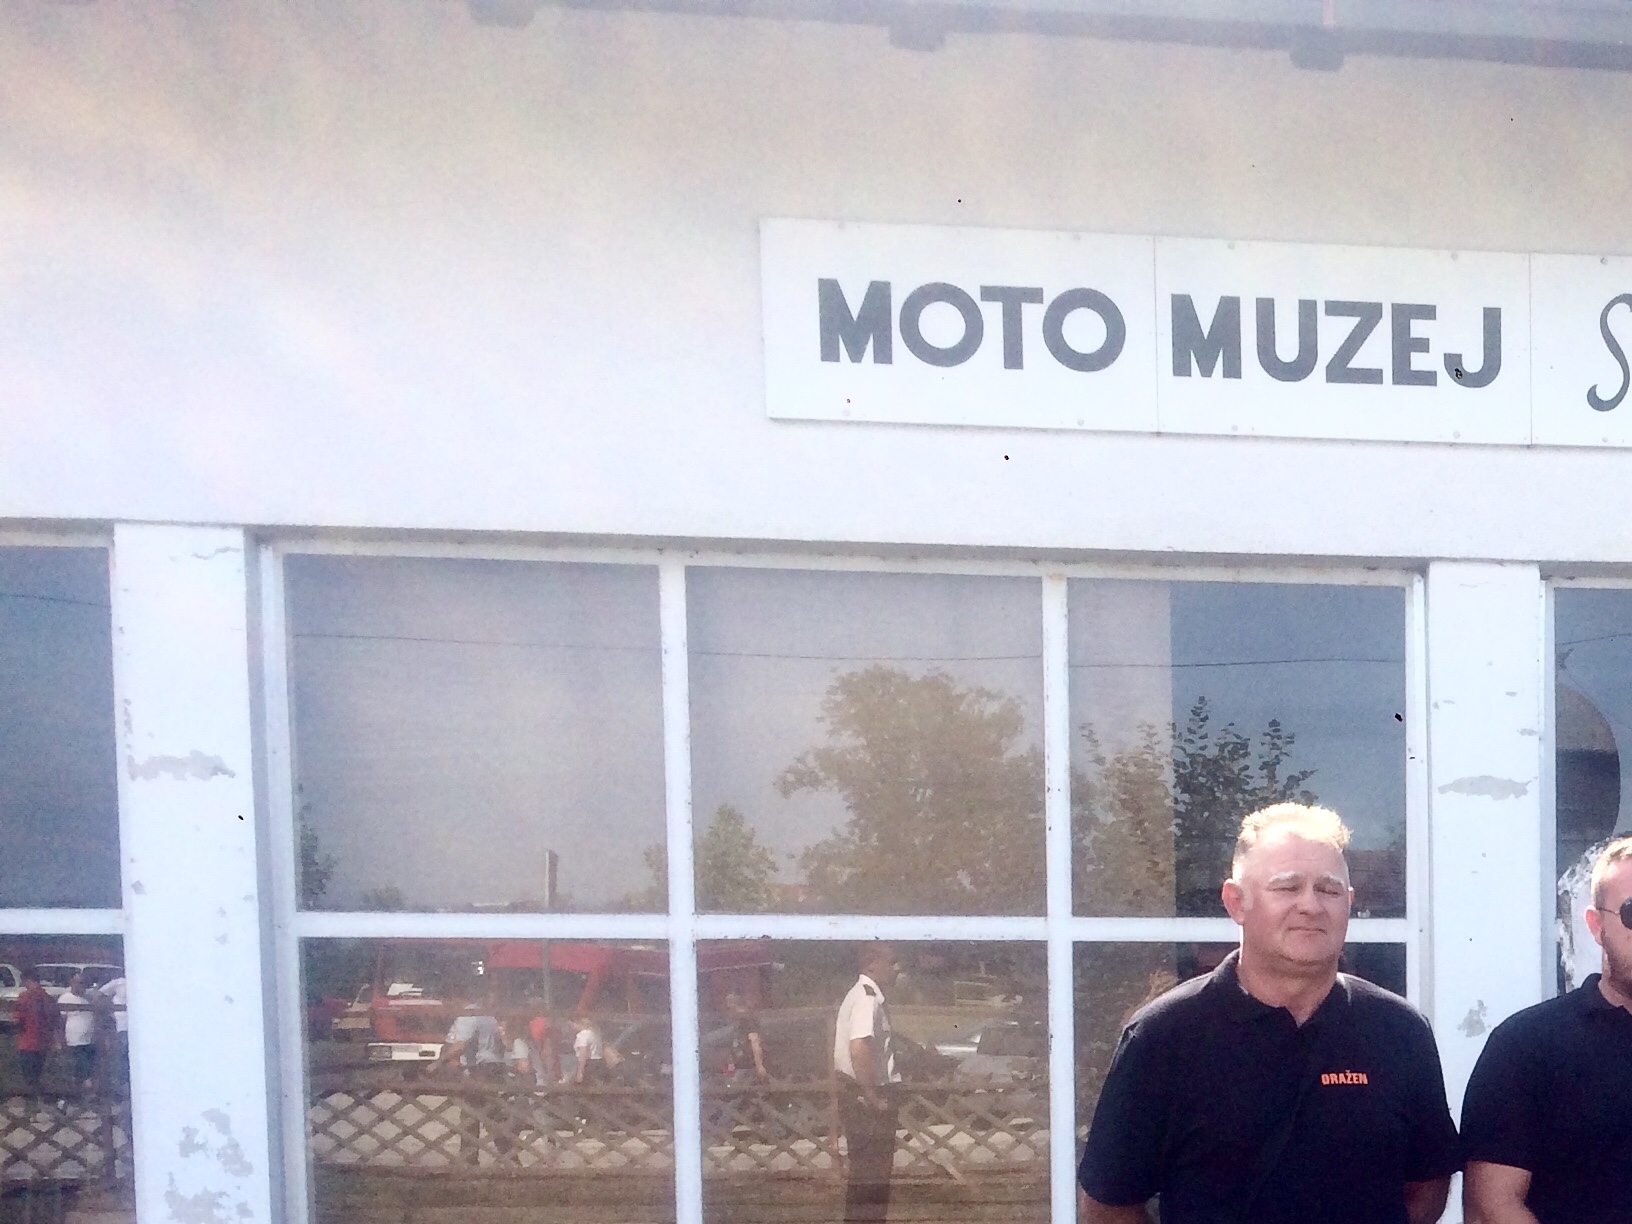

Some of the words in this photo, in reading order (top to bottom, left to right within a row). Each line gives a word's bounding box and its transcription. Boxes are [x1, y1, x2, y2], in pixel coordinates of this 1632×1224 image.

[818, 278, 1126, 373] MOTO
[1171, 293, 1502, 388] MUZEJ
[1320, 1069, 1368, 1085] DRAŽEN
